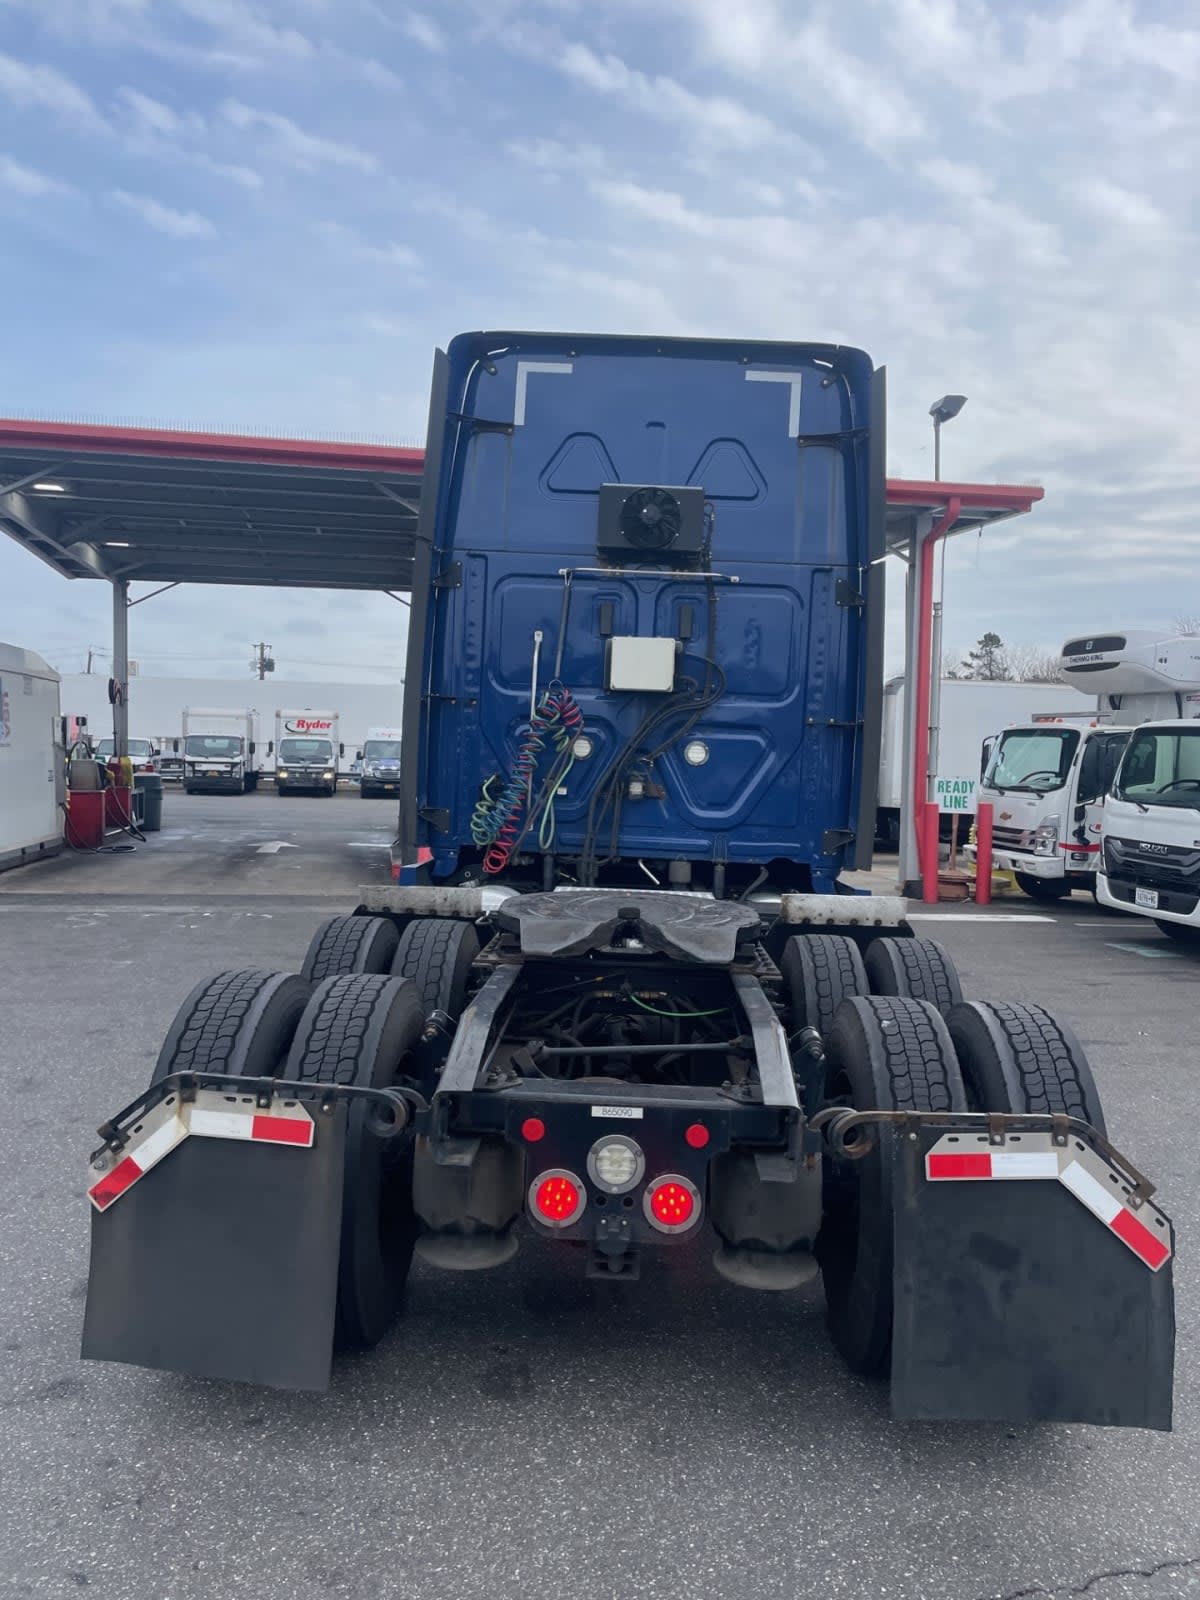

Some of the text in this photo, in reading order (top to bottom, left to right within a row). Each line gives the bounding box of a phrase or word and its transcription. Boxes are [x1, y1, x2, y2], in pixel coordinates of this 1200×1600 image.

[296, 719, 332, 733] Ryder
[937, 780, 975, 793] READY
[943, 795, 968, 809] LINE
